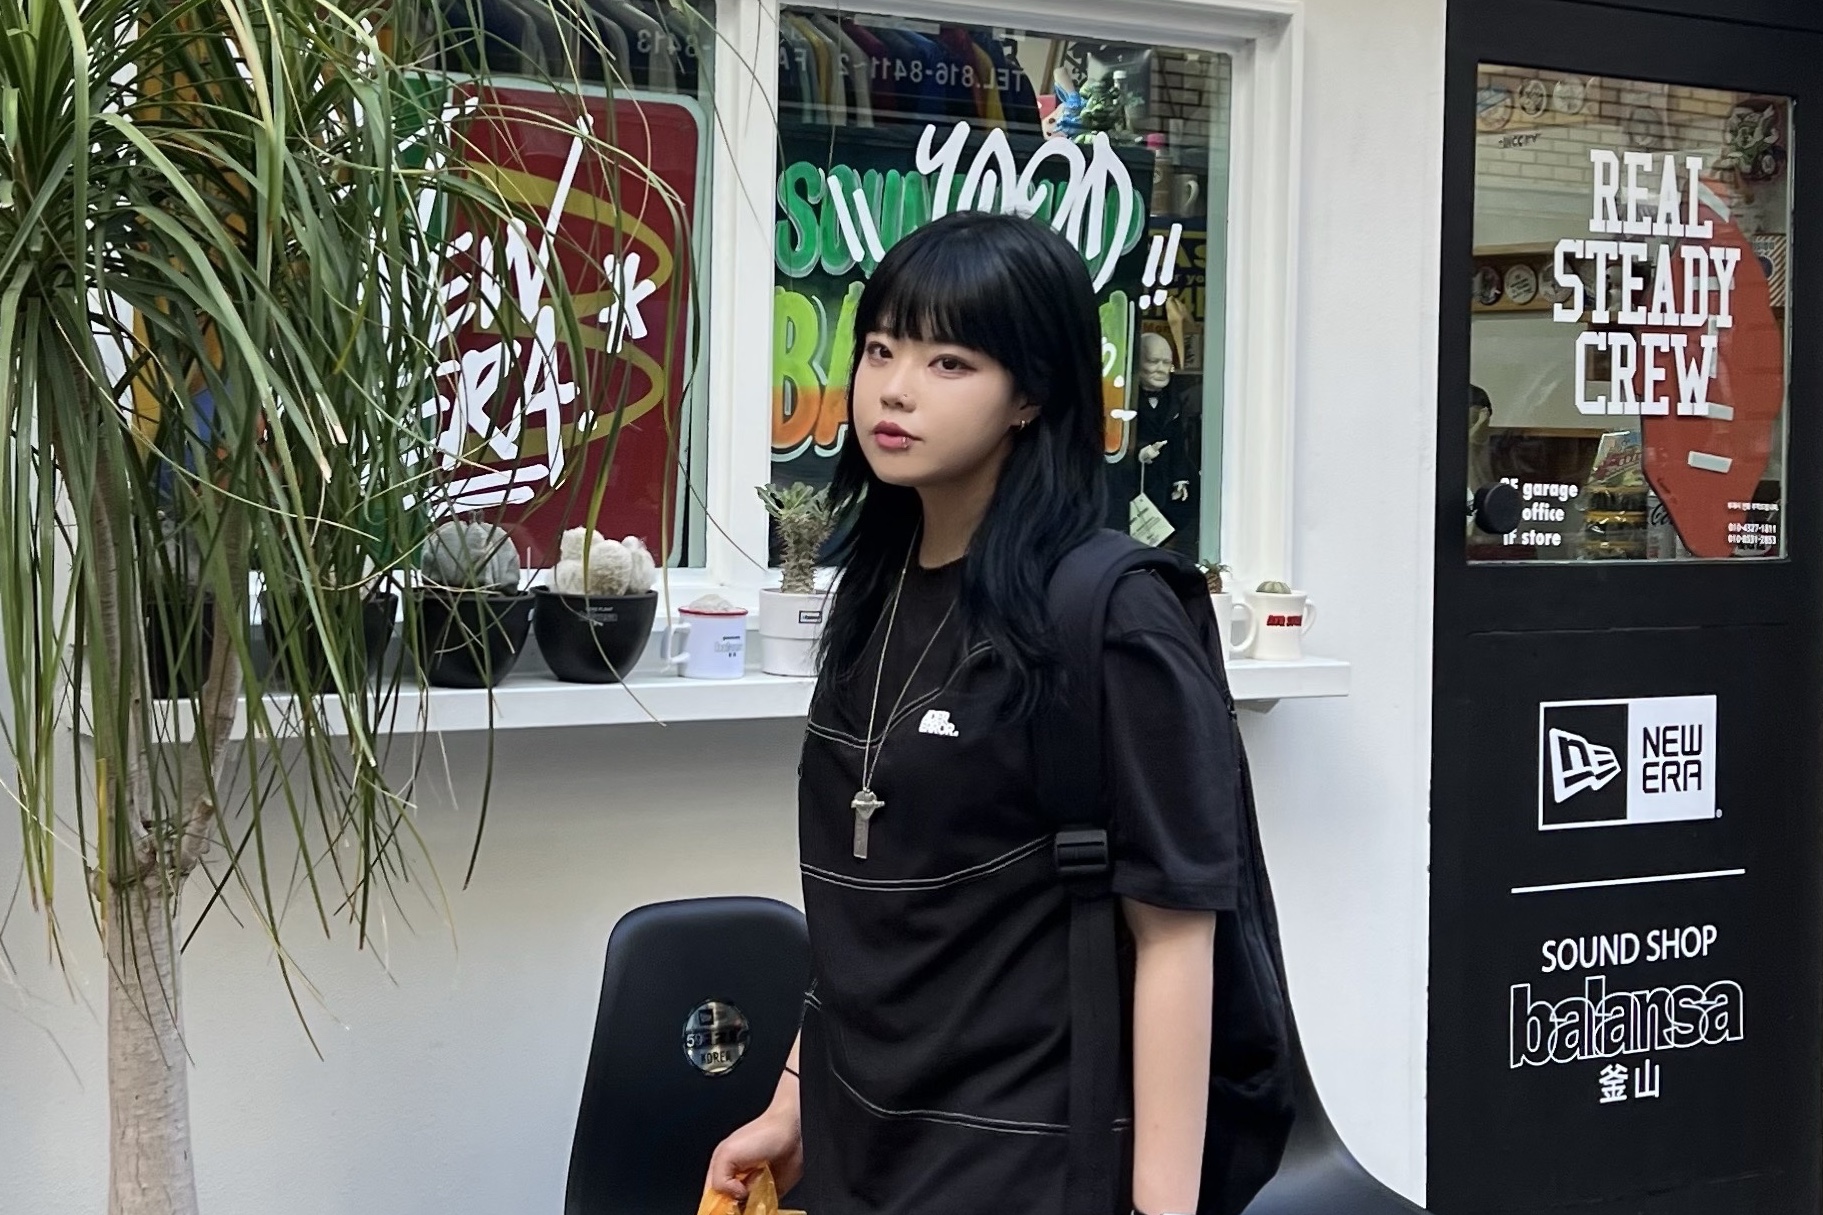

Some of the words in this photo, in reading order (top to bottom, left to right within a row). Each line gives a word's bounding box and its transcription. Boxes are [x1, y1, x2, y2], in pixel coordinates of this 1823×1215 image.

[1589, 149, 1713, 239] REAL
[1553, 238, 1741, 328] STEADY
[1575, 331, 1717, 416] CREW
[1521, 501, 1565, 521] office
[1522, 482, 1578, 502] garage
[1521, 529, 1562, 546] store
[1642, 724, 1702, 758] NEW
[1642, 759, 1702, 794] ERA
[1541, 932, 1640, 973] SOUND
[1646, 924, 1718, 962] SHOP
[1509, 974, 1744, 1069] balansa
[1599, 1058, 1660, 1104] 釜山
